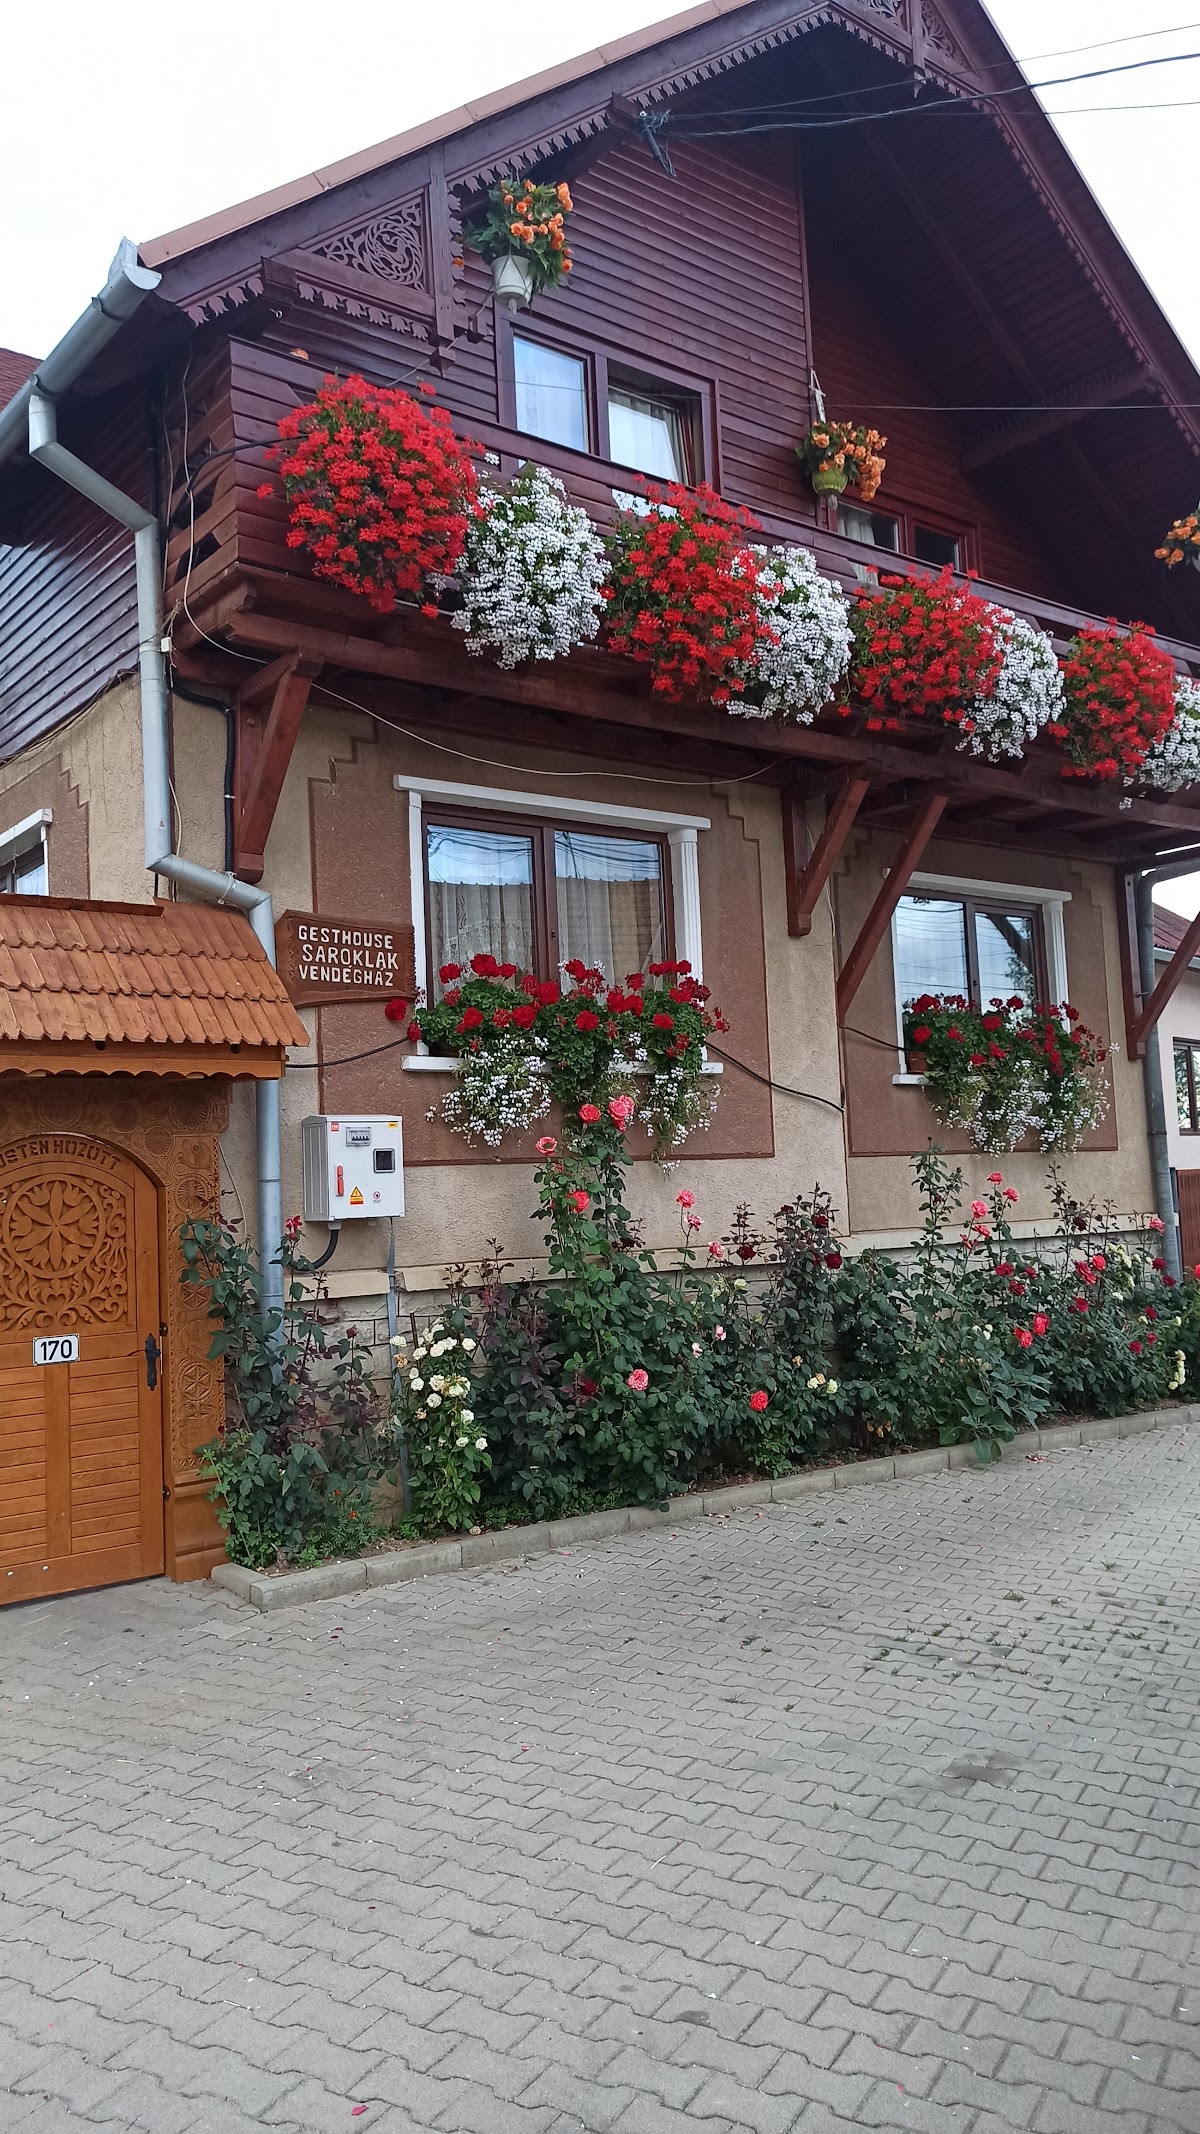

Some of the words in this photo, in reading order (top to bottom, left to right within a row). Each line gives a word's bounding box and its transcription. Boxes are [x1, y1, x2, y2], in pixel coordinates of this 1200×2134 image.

[298, 925, 394, 950] GESTHOUSE
[302, 944, 399, 970] SAROKLAK
[298, 964, 394, 987] VENDÉGHÁZ
[53, 1139, 122, 1170] HOZOTT
[40, 1339, 73, 1361] 170
